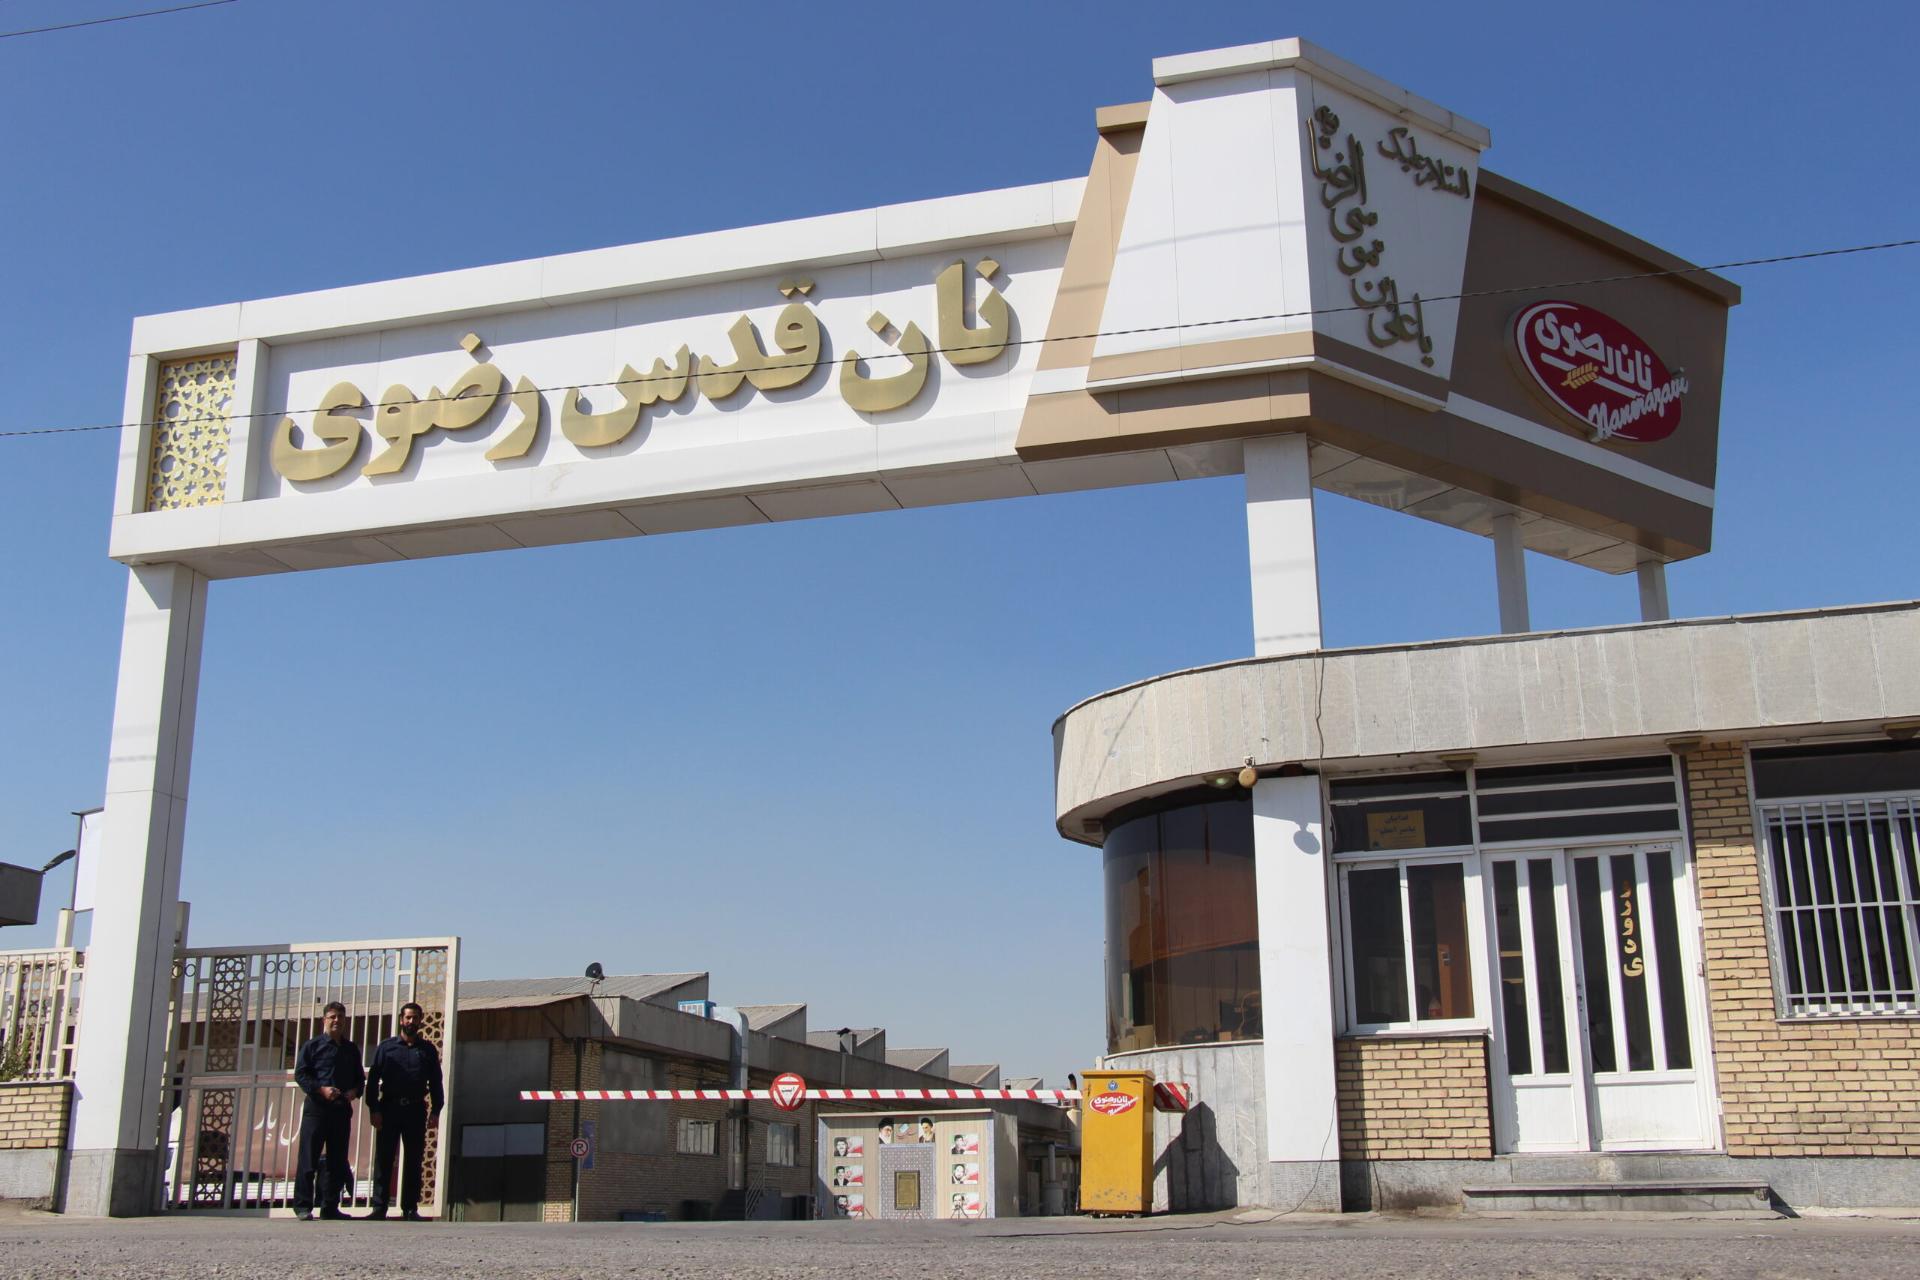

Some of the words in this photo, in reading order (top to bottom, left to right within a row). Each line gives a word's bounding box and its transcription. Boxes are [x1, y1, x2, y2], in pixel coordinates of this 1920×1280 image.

[272, 332, 541, 481] رضوی
[563, 277, 823, 448] قدس
[841, 257, 1009, 412] نان
[1615, 344, 1653, 391] نان
